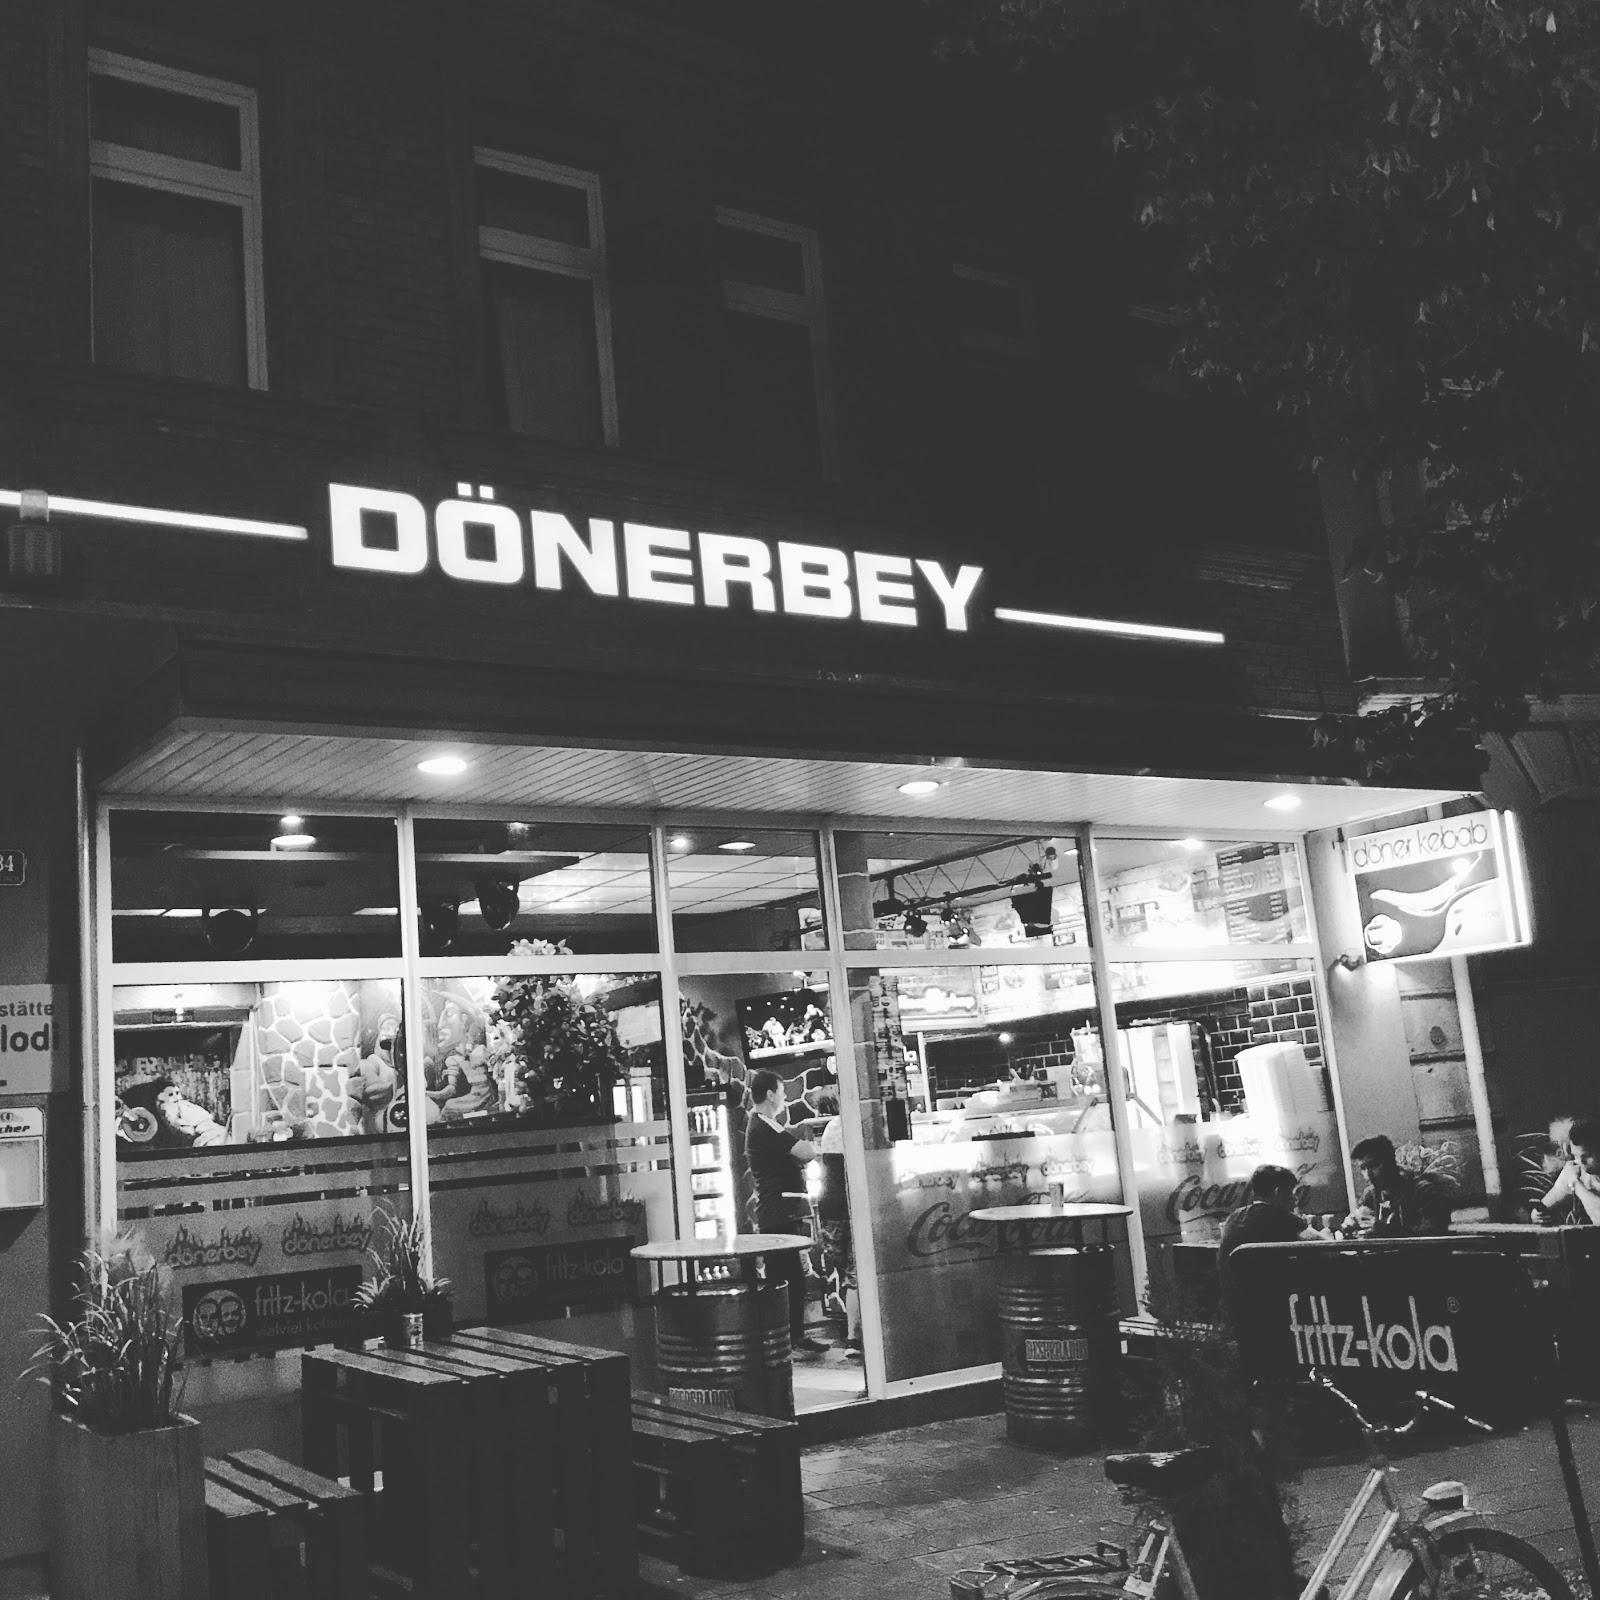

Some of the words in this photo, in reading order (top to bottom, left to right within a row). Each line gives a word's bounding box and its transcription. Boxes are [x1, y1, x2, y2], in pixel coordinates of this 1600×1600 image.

[329, 482, 983, 632] DÖNERBEY
[1353, 837, 1413, 868] döner
[1417, 819, 1488, 856] kebab
[1289, 1293, 1458, 1372] fritz-kola
